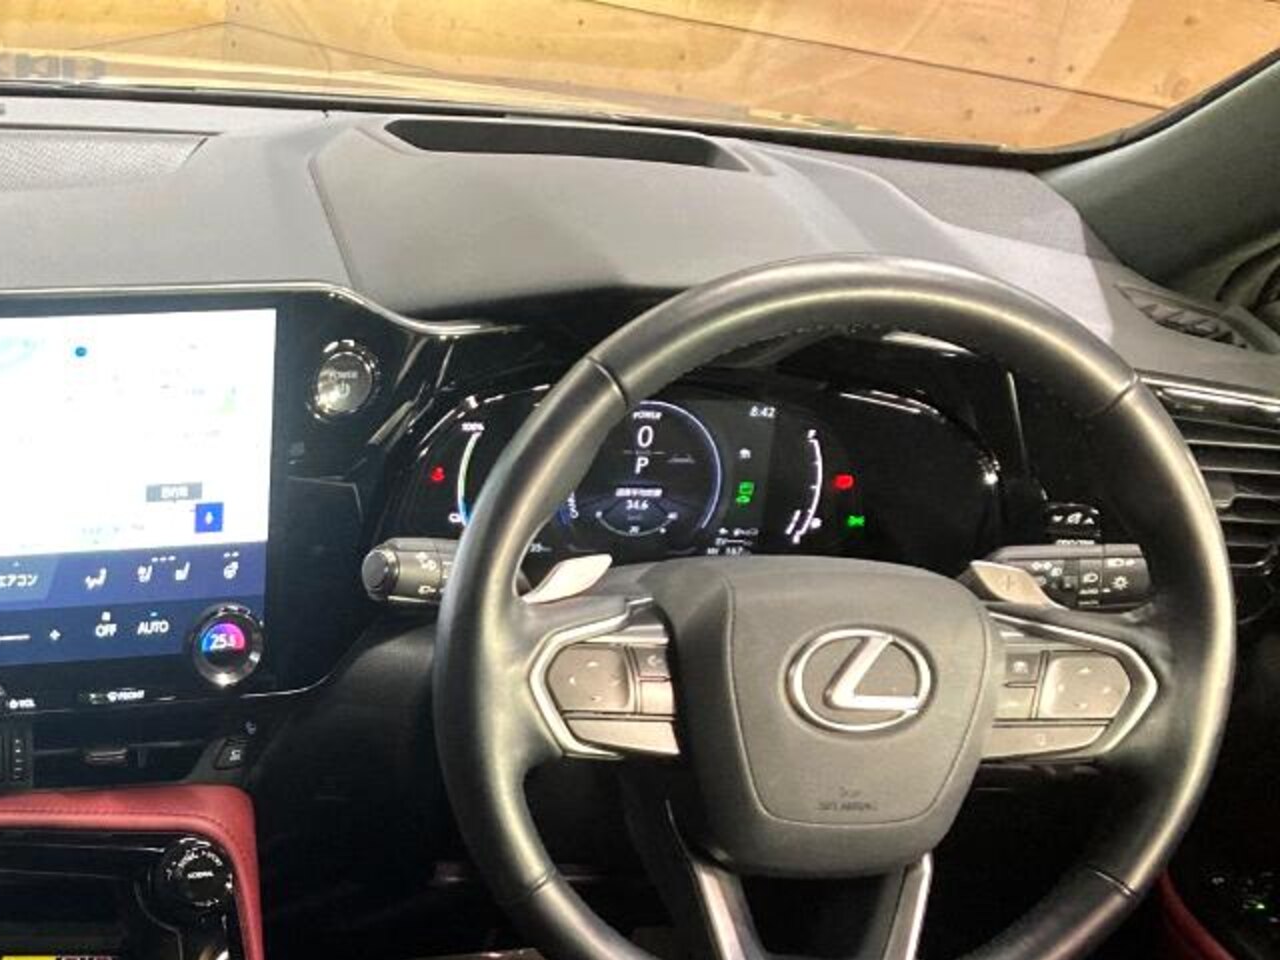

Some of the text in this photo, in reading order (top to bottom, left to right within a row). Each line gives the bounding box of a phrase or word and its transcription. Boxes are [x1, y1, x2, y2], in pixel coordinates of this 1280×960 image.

[749, 406, 776, 418] 8:42
[637, 425, 654, 448] 0
[635, 457, 650, 474] P
[95, 623, 118, 638] OFF
[136, 619, 170, 635] AUTO
